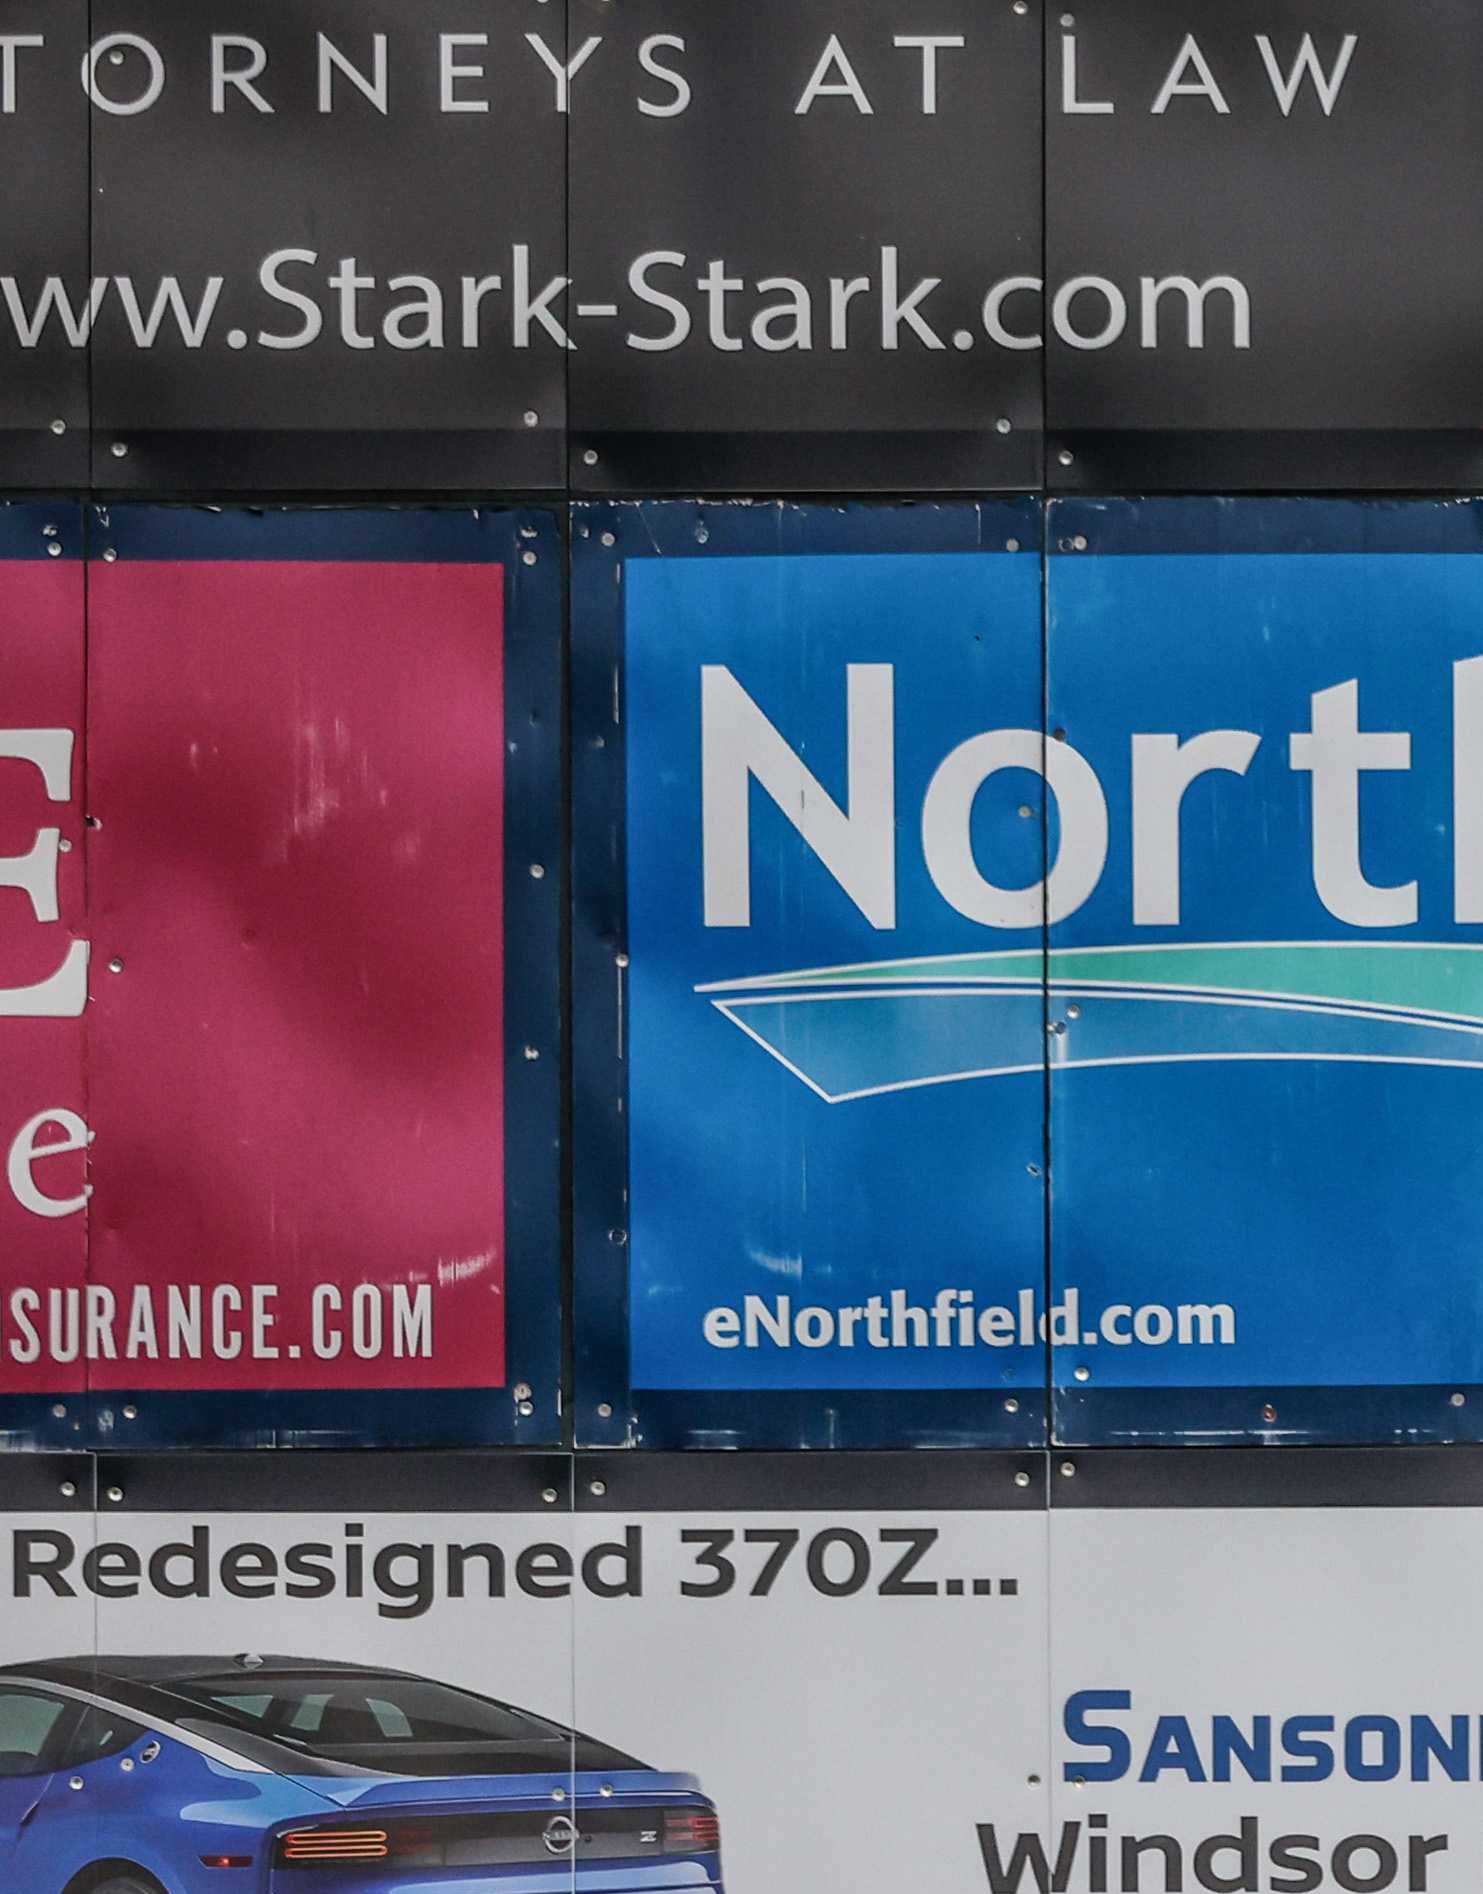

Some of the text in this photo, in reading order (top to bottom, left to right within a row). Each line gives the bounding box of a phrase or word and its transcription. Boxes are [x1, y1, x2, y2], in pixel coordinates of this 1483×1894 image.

[0, 33, 1357, 117] TORNEYS AT LAW
[10, 1282, 432, 1362] SURANCE.COM
[703, 1288, 1235, 1348] eNorthfield.com
[13, 1523, 1017, 1619] Redesigned 370Z...
[976, 1818, 1448, 1894] Windsor
